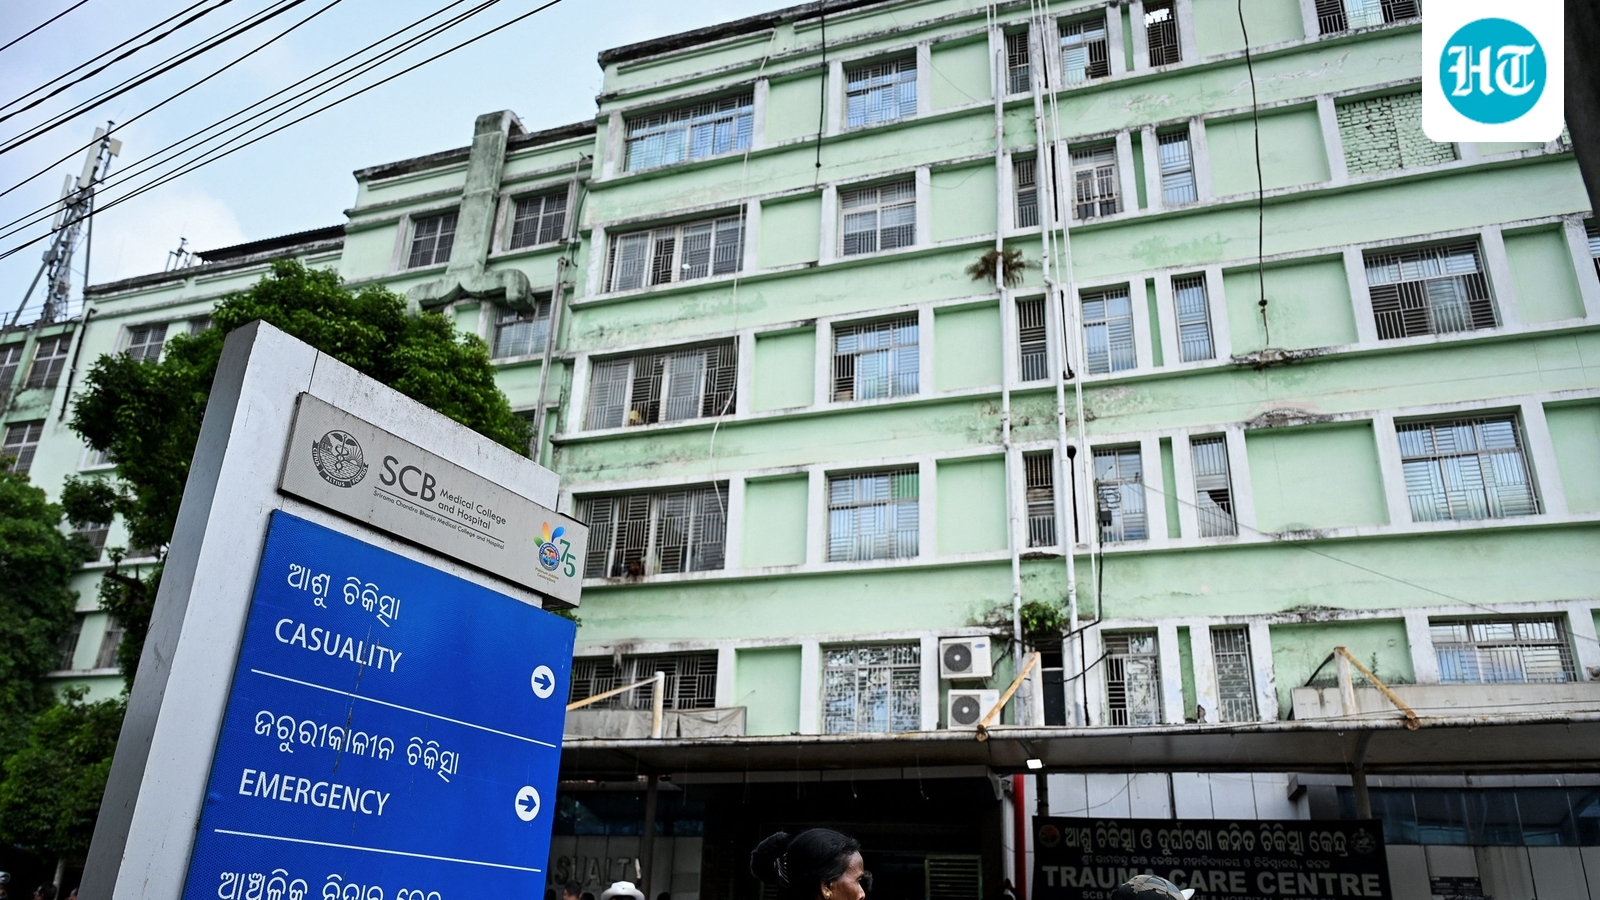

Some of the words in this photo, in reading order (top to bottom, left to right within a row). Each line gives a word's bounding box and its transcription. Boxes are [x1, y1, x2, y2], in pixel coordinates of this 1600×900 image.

[325, 476, 345, 487] ALTIUS
[379, 455, 436, 502] SCB
[373, 490, 395, 504] Srirama
[396, 499, 419, 514] Chandra
[420, 509, 437, 523] Bhanja
[437, 516, 457, 531] Medical
[458, 525, 476, 539] College
[476, 533, 486, 542] and
[486, 537, 505, 550] Hospital
[438, 502, 455, 514] and
[457, 508, 491, 530] Hospital
[440, 488, 474, 510] Medical
[476, 504, 506, 525] College
[559, 538, 576, 578] 75
[287, 563, 331, 609] ଆଶୁ
[275, 618, 402, 673] CASUALITY
[254, 710, 395, 761] ଜରୁରୀକାଳୀନ
[238, 768, 390, 816] EMERGENCY
[1064, 826, 1094, 854] ଆଶୁ
[1082, 890, 1104, 900] SCB
[1168, 868, 1248, 893] CARE
[1256, 870, 1383, 897] CENTRE
